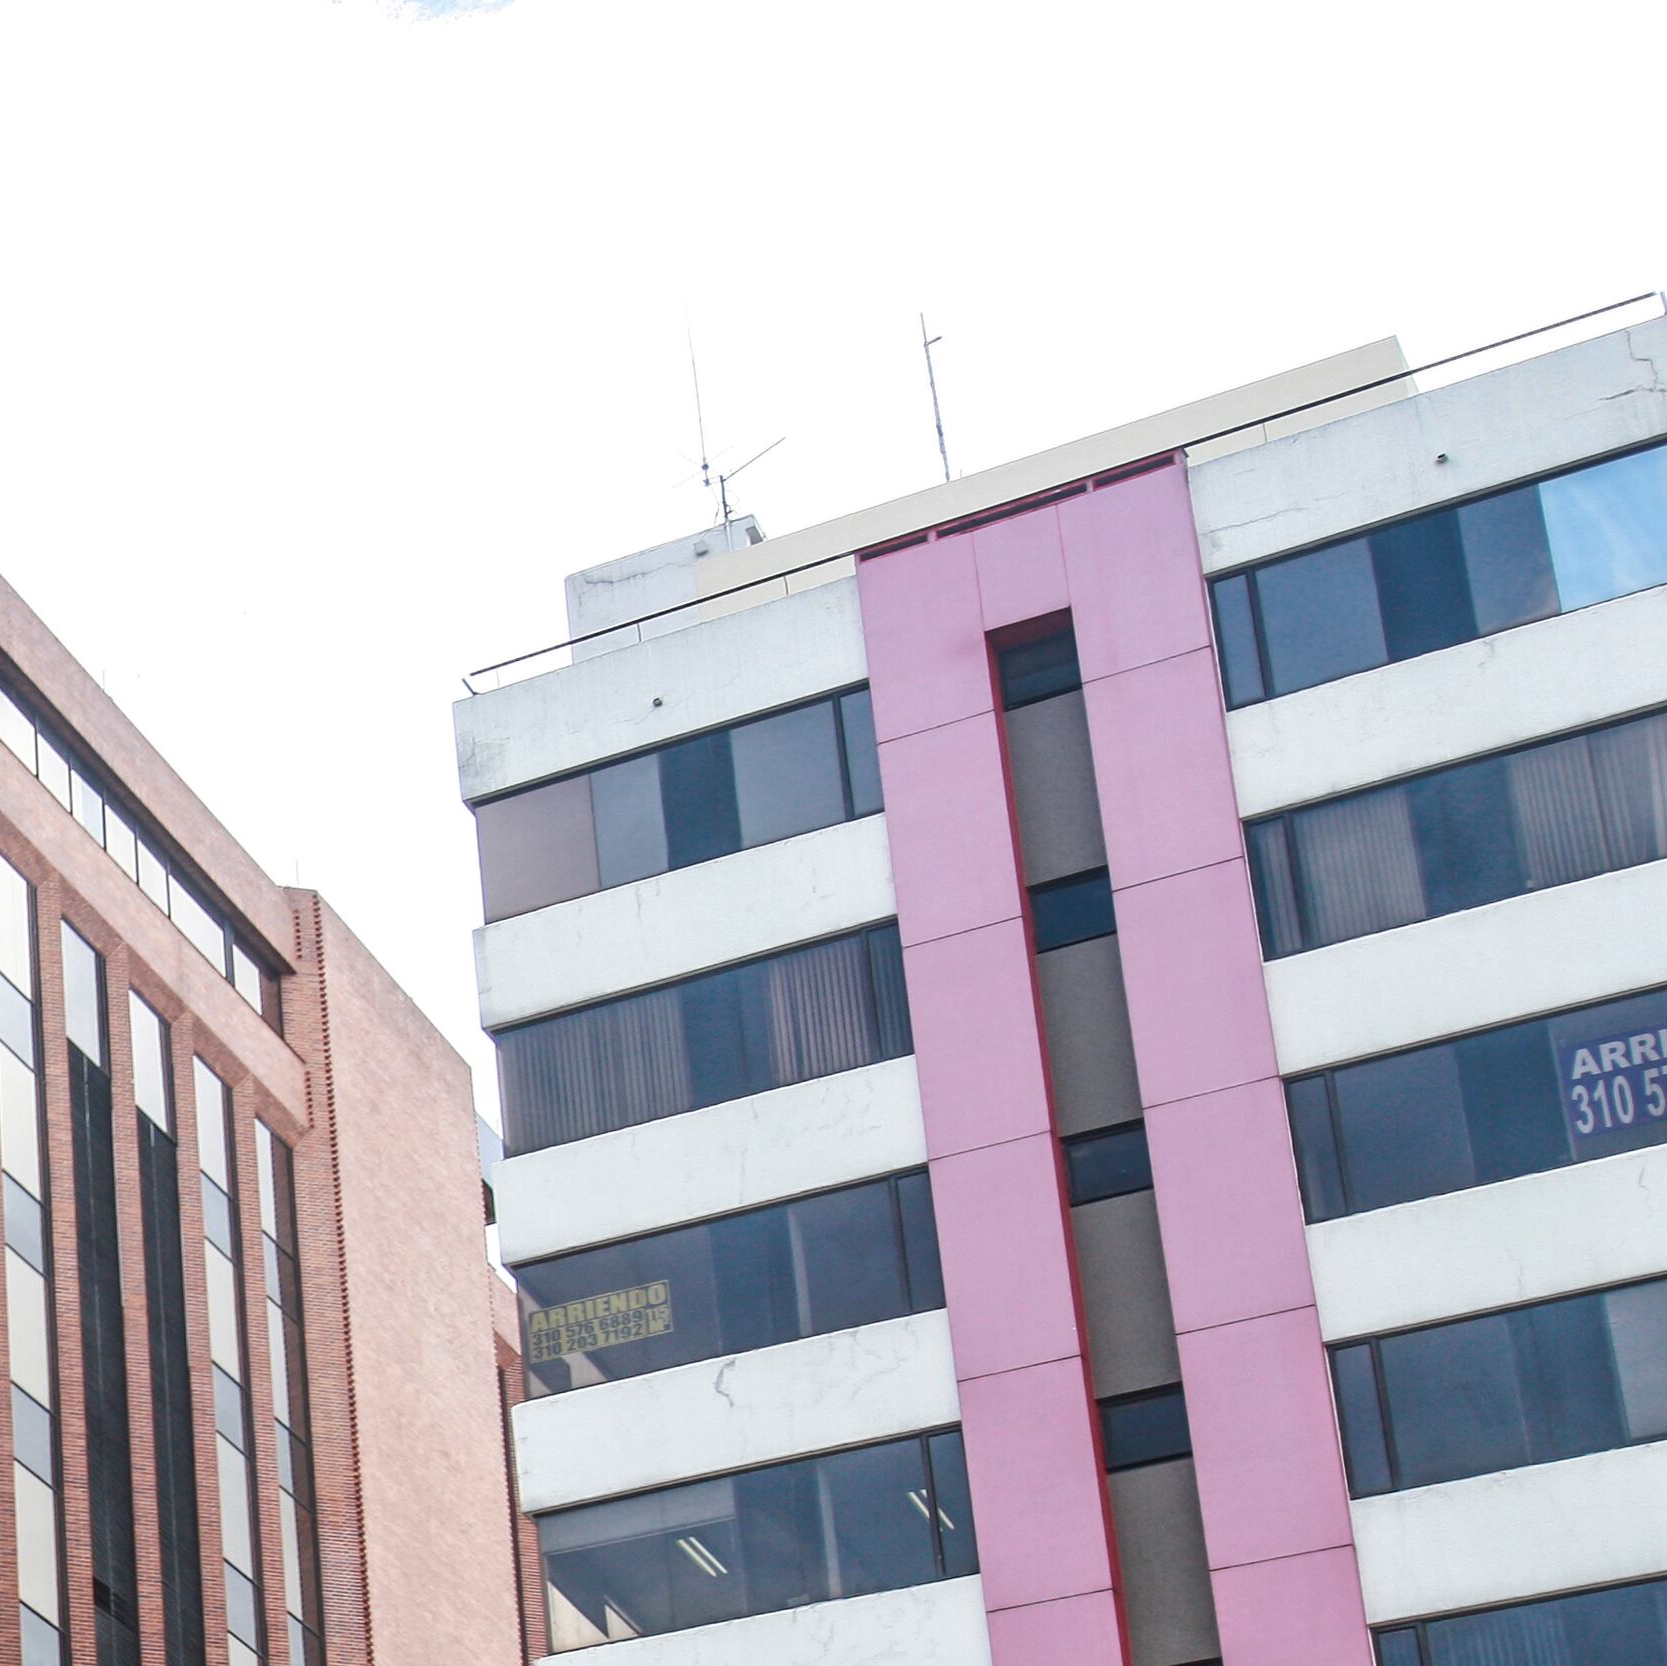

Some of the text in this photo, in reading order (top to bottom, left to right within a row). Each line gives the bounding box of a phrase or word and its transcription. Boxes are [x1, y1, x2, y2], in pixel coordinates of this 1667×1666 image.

[1572, 1075, 1634, 1134] 310
[530, 1283, 667, 1333] ARRIENDO
[533, 1330, 561, 1347] 310
[567, 1321, 594, 1338] 576
[534, 1341, 562, 1359] 310
[567, 1334, 598, 1351] 203
[602, 1323, 643, 1343] 7192
